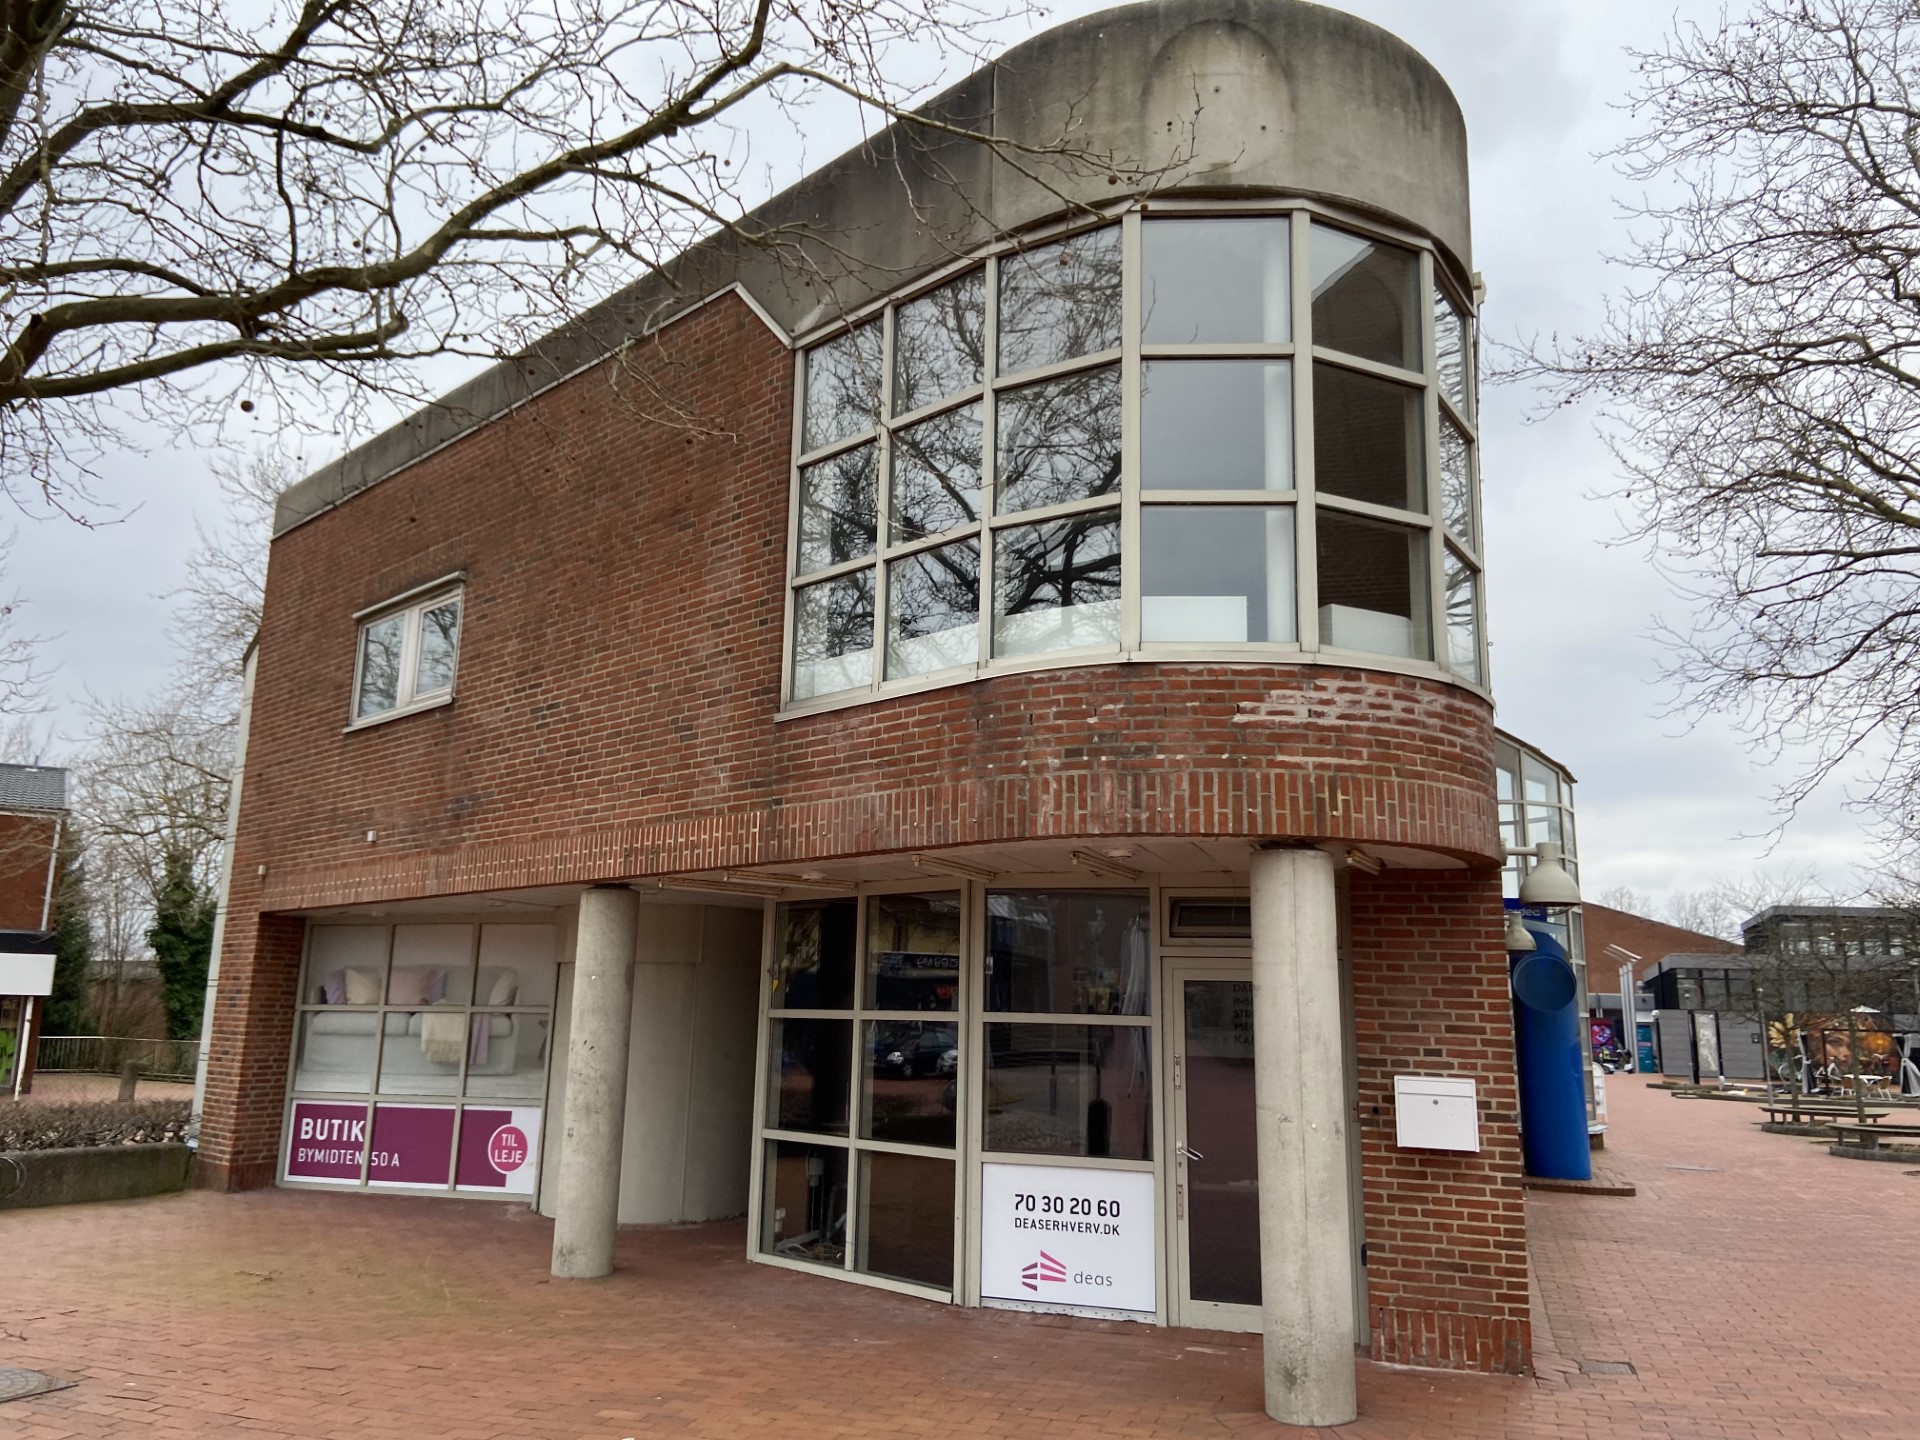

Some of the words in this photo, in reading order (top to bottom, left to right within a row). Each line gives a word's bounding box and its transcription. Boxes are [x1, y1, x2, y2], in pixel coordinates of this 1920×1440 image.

[300, 1117, 365, 1142] BUTIK
[501, 1134, 518, 1147] TIL
[297, 1148, 364, 1166] BYMIDTEN
[371, 1151, 388, 1166] 50
[391, 1153, 400, 1167] A
[494, 1149, 523, 1164] LEJE
[1014, 1193, 1036, 1212] 70
[1041, 1196, 1064, 1214] 30
[1069, 1197, 1091, 1216] 20
[1097, 1199, 1120, 1218] 60
[1014, 1217, 1120, 1236] DEASERHVERV.DK
[1073, 1271, 1113, 1287] deas
